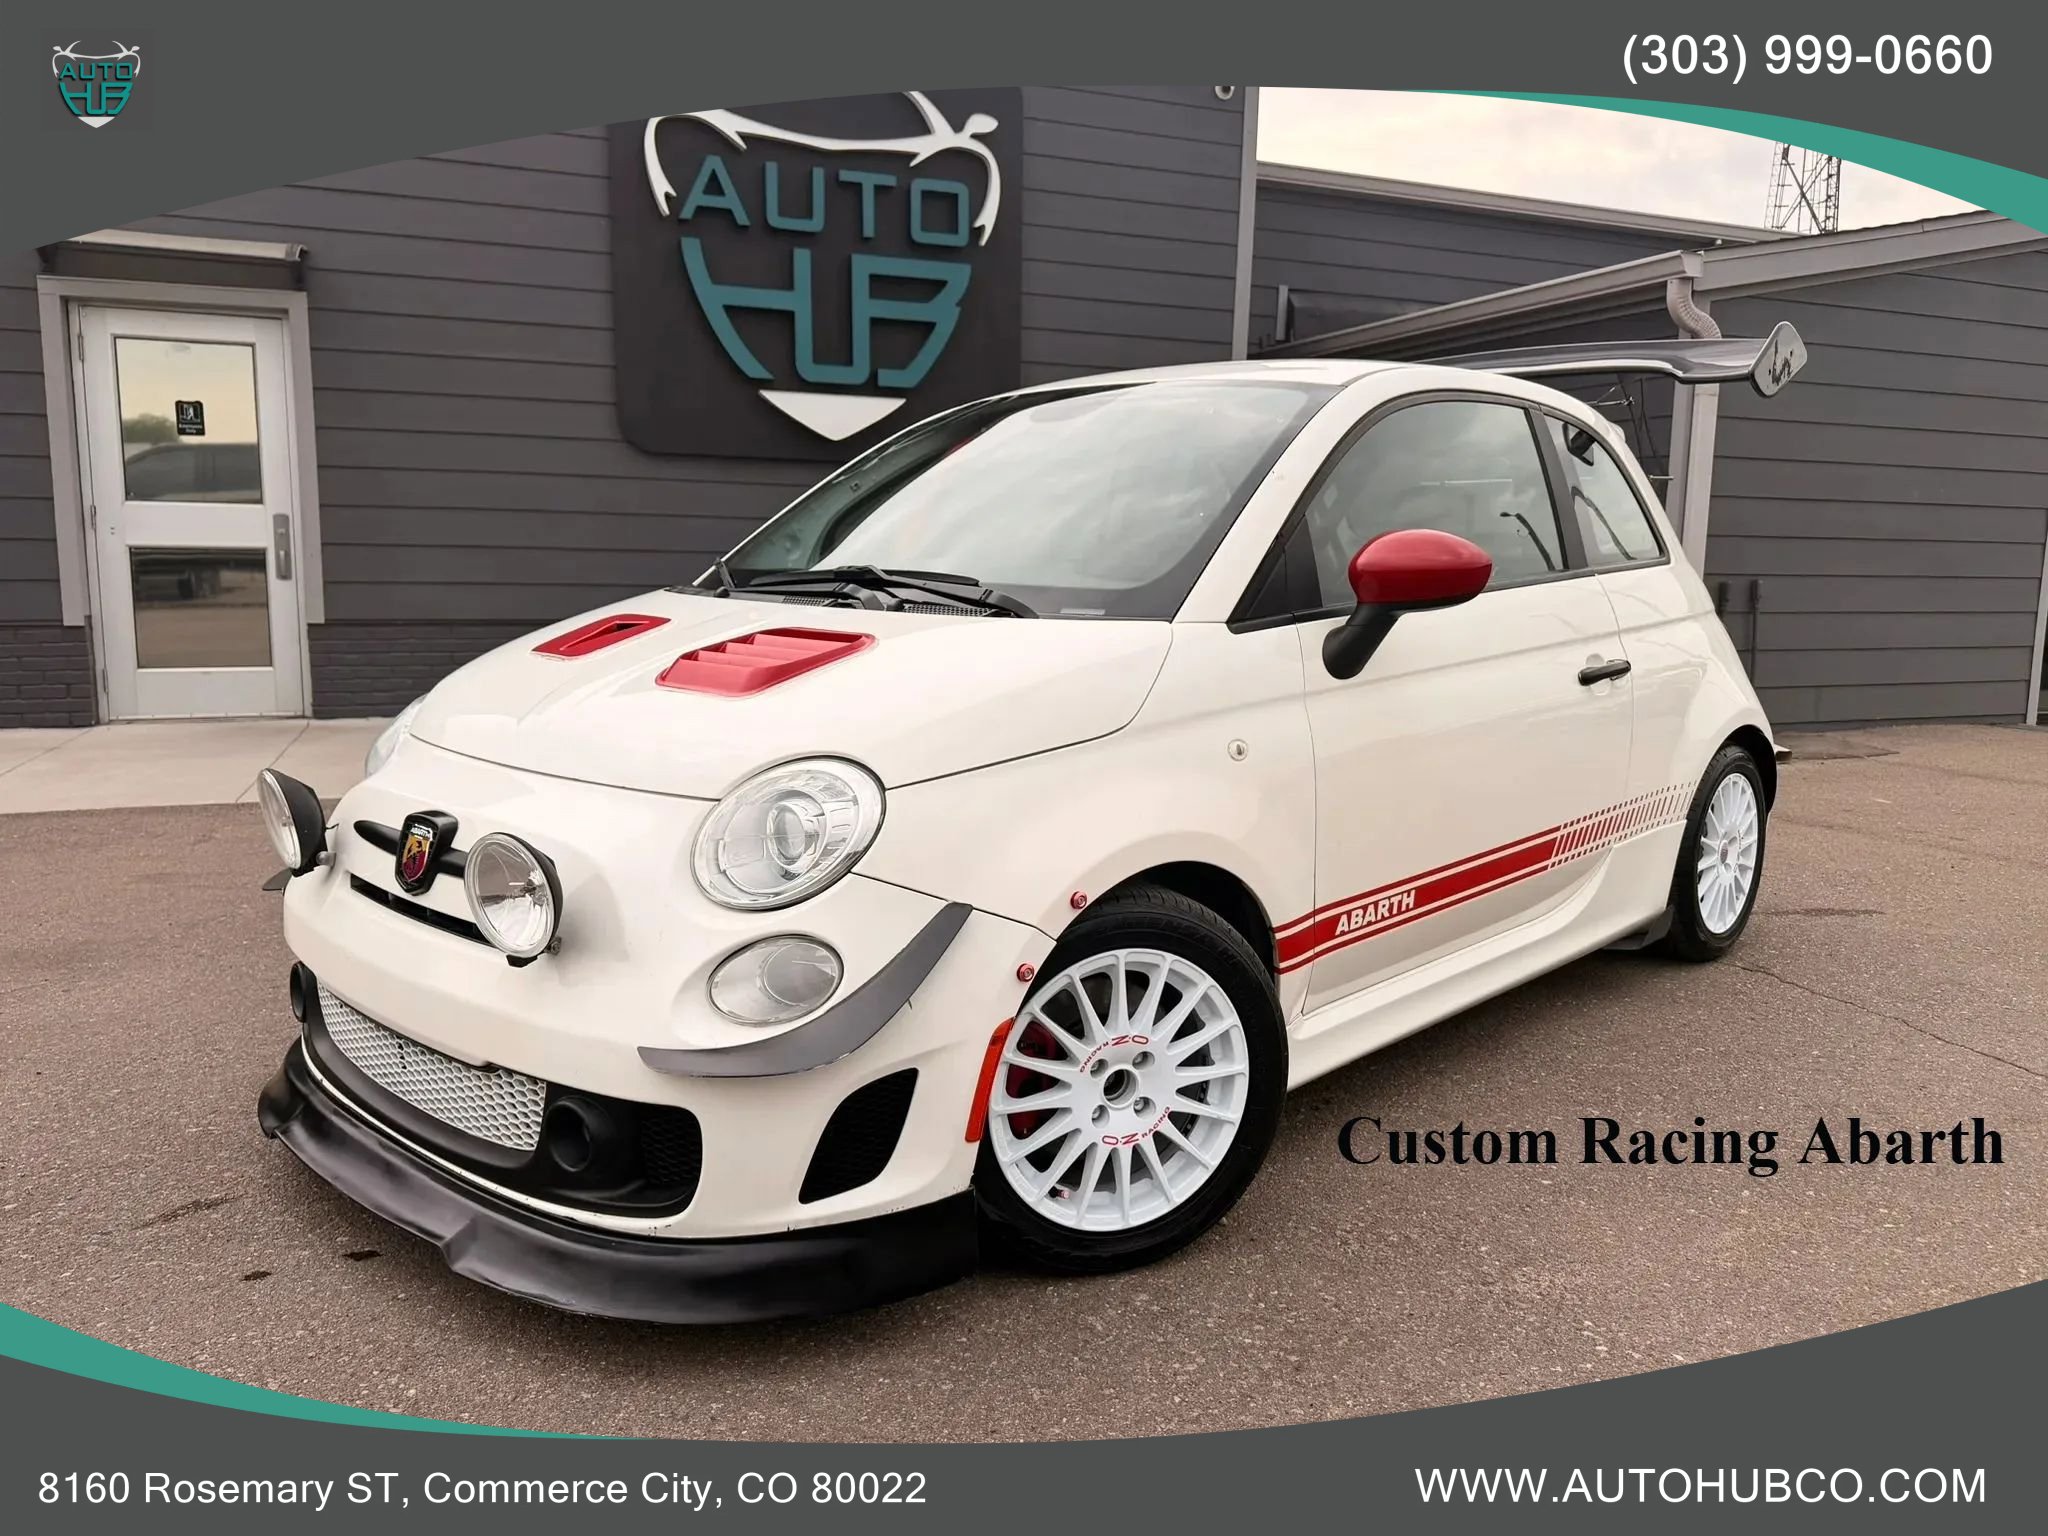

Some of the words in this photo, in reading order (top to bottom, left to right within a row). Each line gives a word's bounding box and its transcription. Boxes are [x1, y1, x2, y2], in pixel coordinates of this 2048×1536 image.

[678, 154, 970, 248] AUTO
[680, 235, 972, 388] HUB
[1334, 889, 1416, 936] ABARTH
[1080, 1041, 1109, 1073] RACING
[1141, 1106, 1170, 1138] RACING
